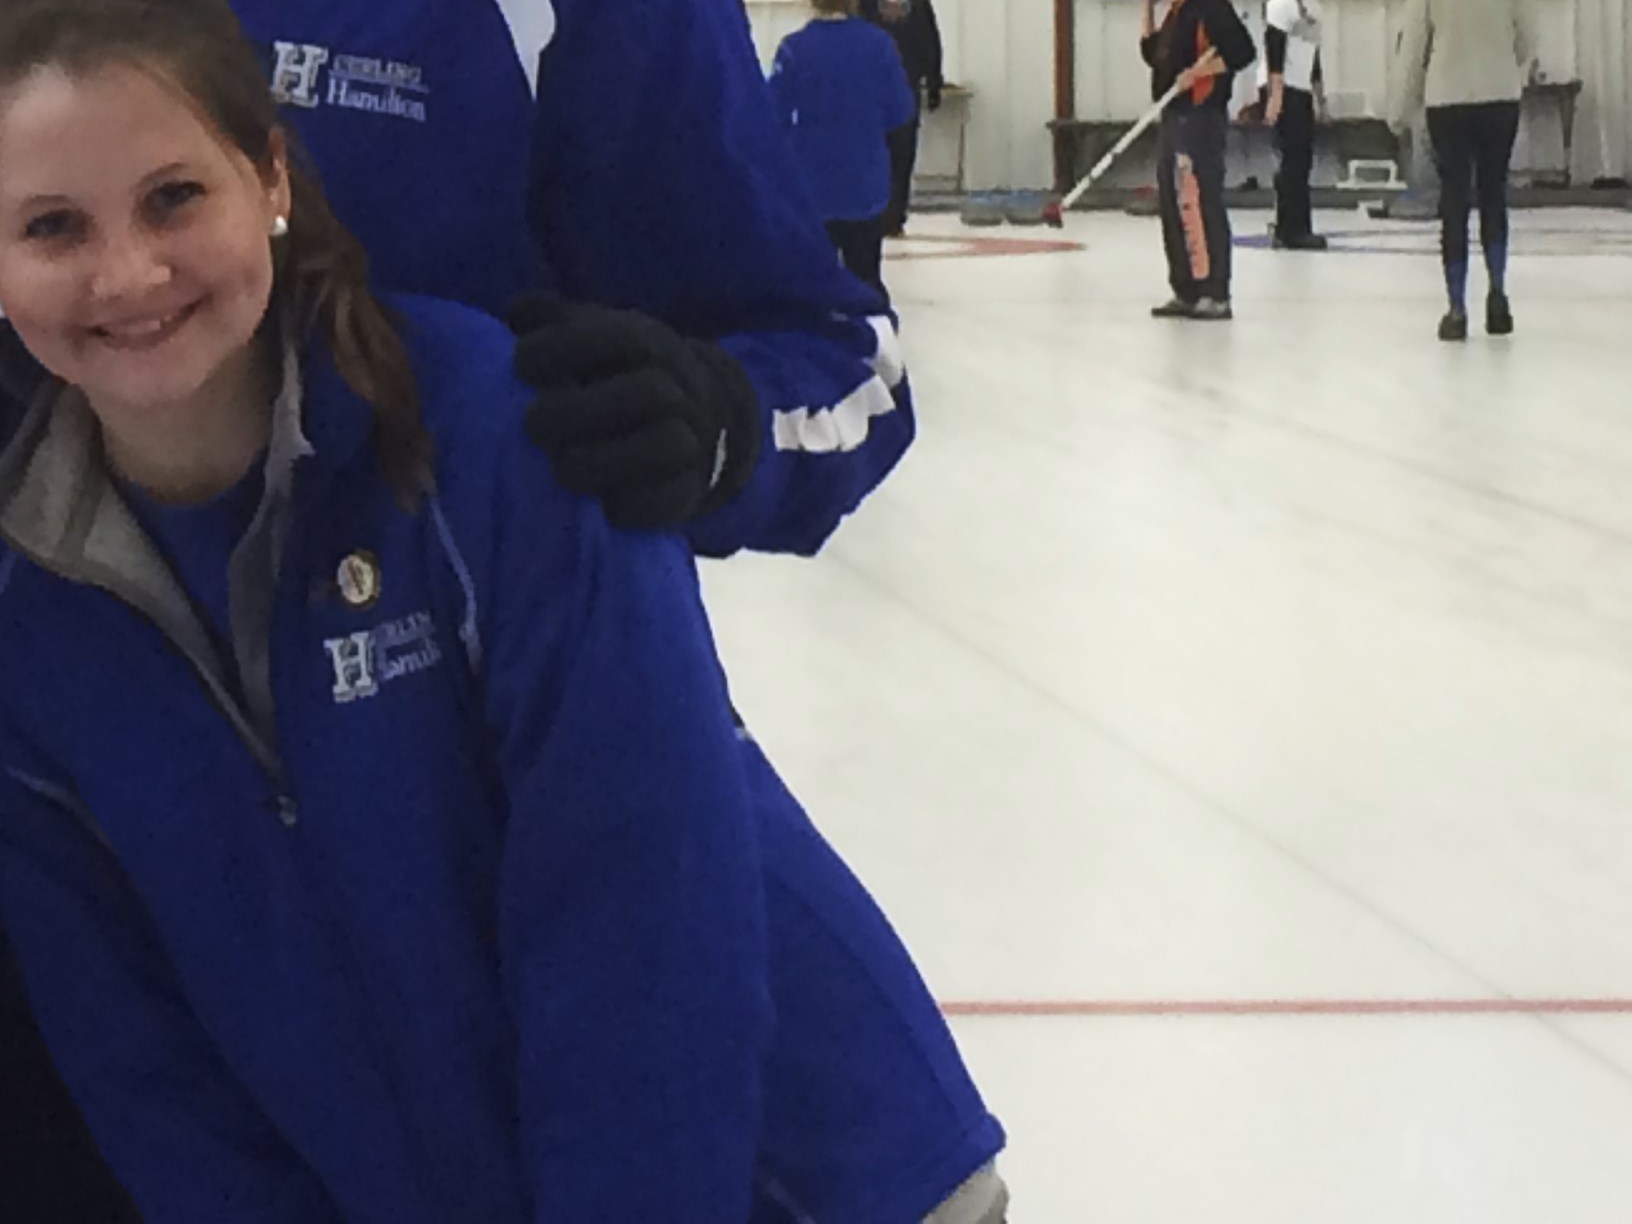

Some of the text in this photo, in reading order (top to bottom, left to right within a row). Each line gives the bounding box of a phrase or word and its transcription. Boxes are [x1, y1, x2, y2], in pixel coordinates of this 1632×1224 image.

[270, 40, 328, 108] H
[326, 77, 427, 122] Hamilton
[323, 632, 378, 703] H
